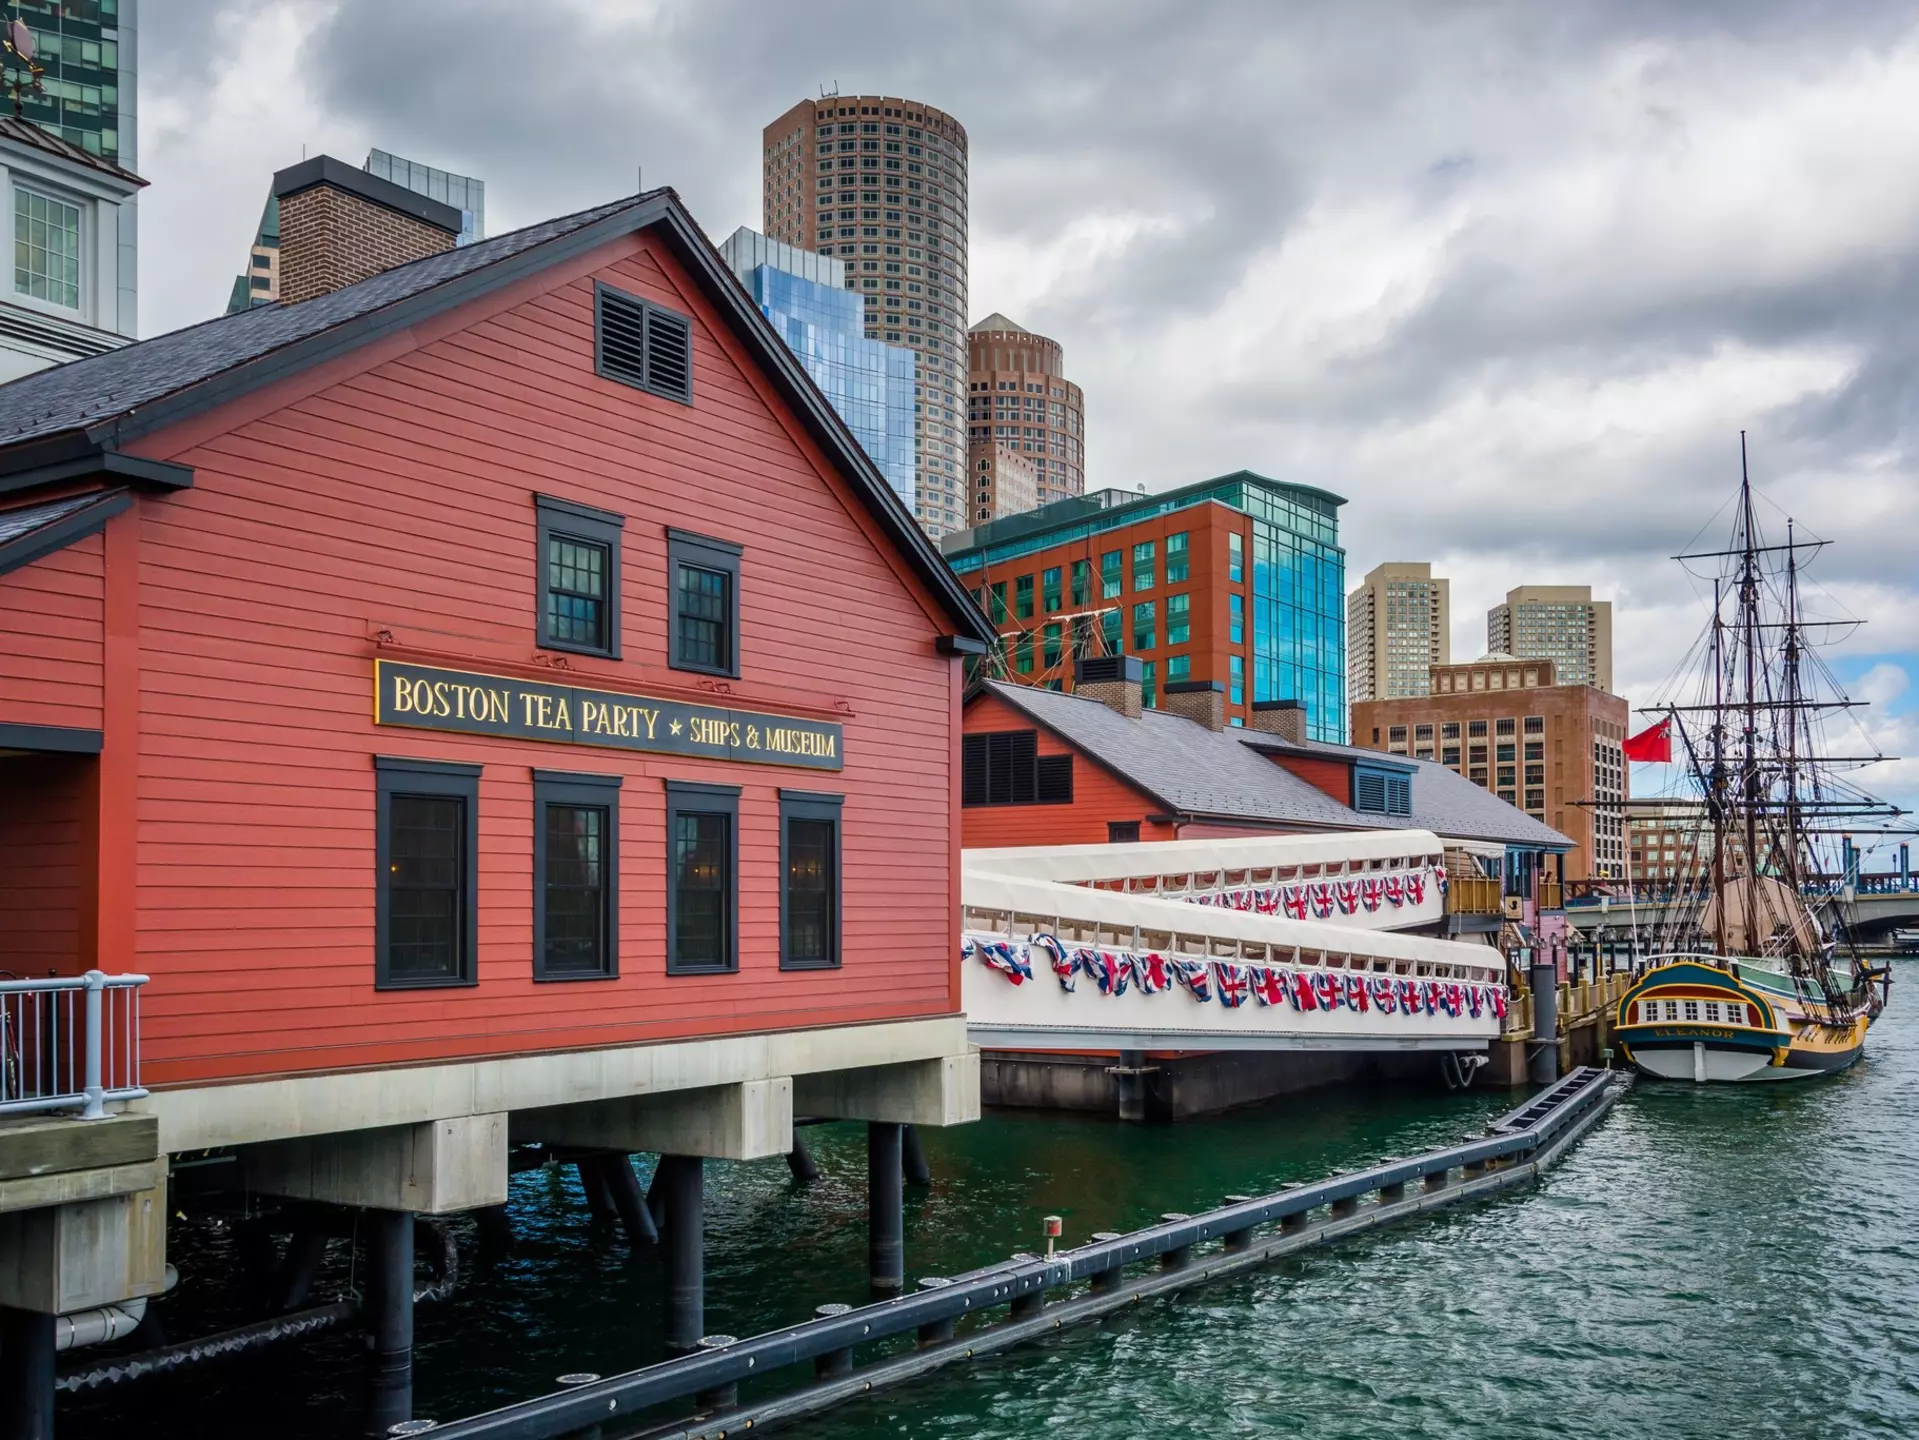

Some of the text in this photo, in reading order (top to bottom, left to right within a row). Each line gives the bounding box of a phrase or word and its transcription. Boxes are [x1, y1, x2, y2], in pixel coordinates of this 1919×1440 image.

[394, 676, 836, 758] BOSTON TEA PARTY SHIPS & MUSEUM
[1653, 1027, 1735, 1039] ELEANOR
